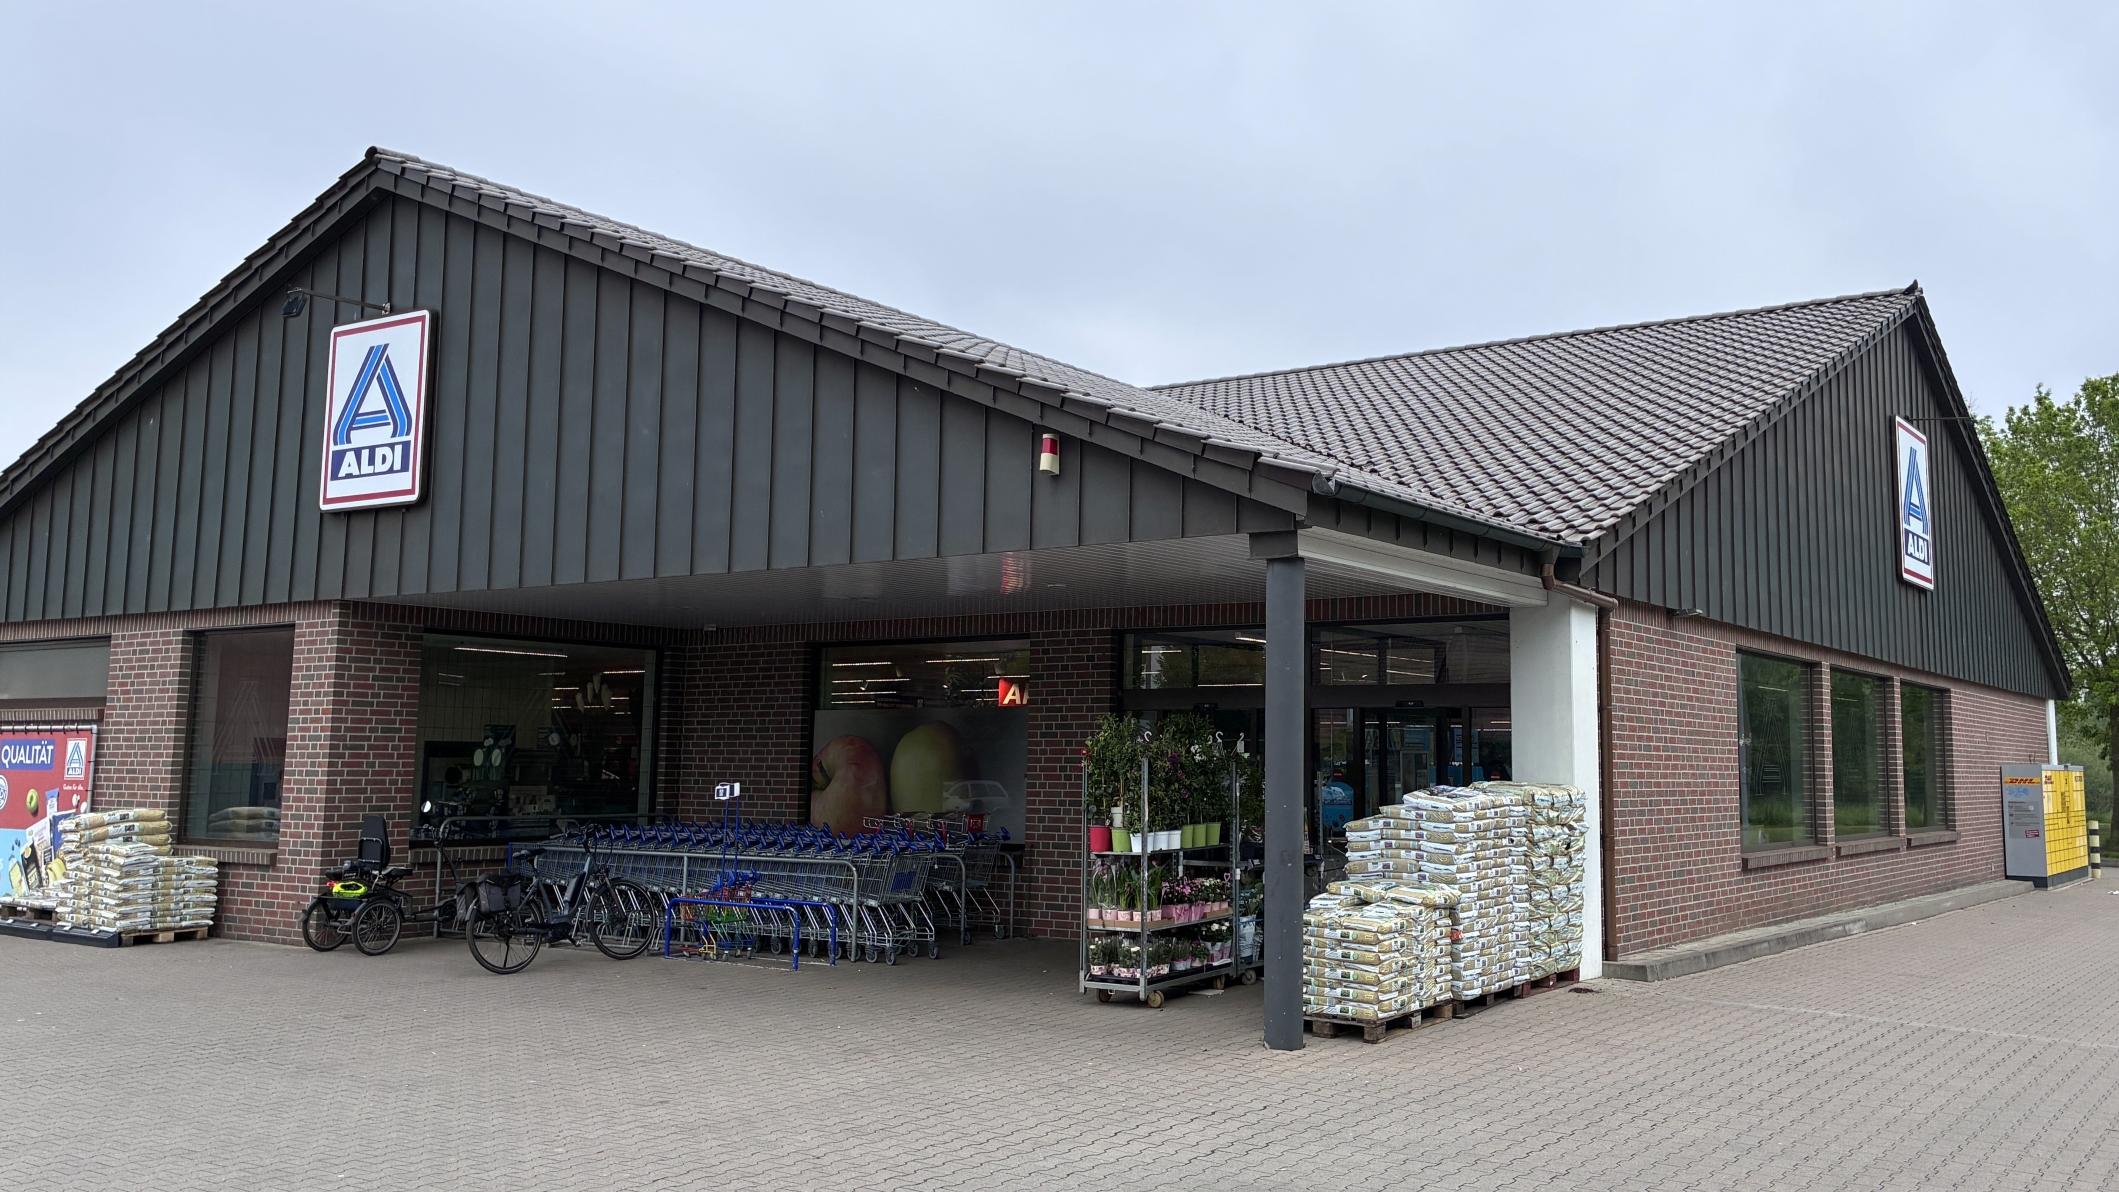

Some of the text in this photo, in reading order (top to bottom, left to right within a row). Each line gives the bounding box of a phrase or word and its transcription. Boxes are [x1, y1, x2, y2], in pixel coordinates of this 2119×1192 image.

[338, 444, 403, 478] ALDI
[1907, 532, 1929, 563] ALDI
[1, 740, 54, 769] QUALITÄT
